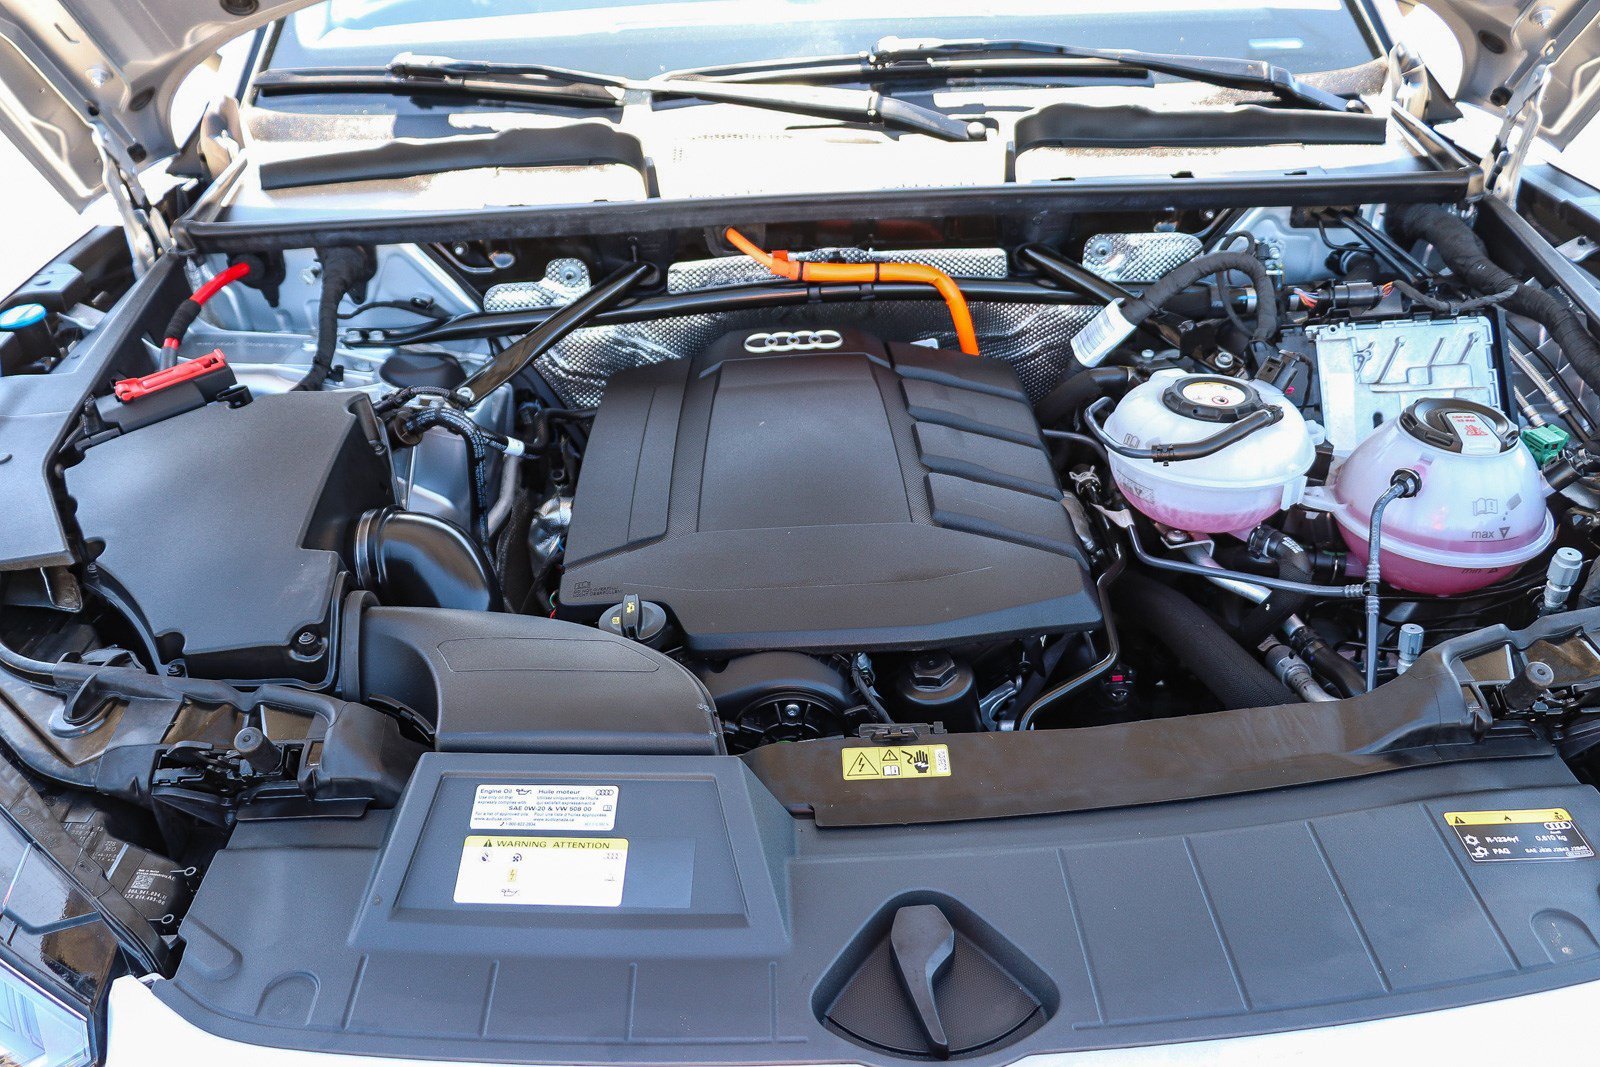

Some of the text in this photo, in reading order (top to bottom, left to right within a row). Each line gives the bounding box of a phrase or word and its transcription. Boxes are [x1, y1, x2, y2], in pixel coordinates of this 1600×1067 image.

[1471, 530, 1495, 539] max
[1556, 834, 1568, 842] kg
[497, 840, 610, 849] WARNING ATTENTION
[1491, 847, 1511, 855] PAG
